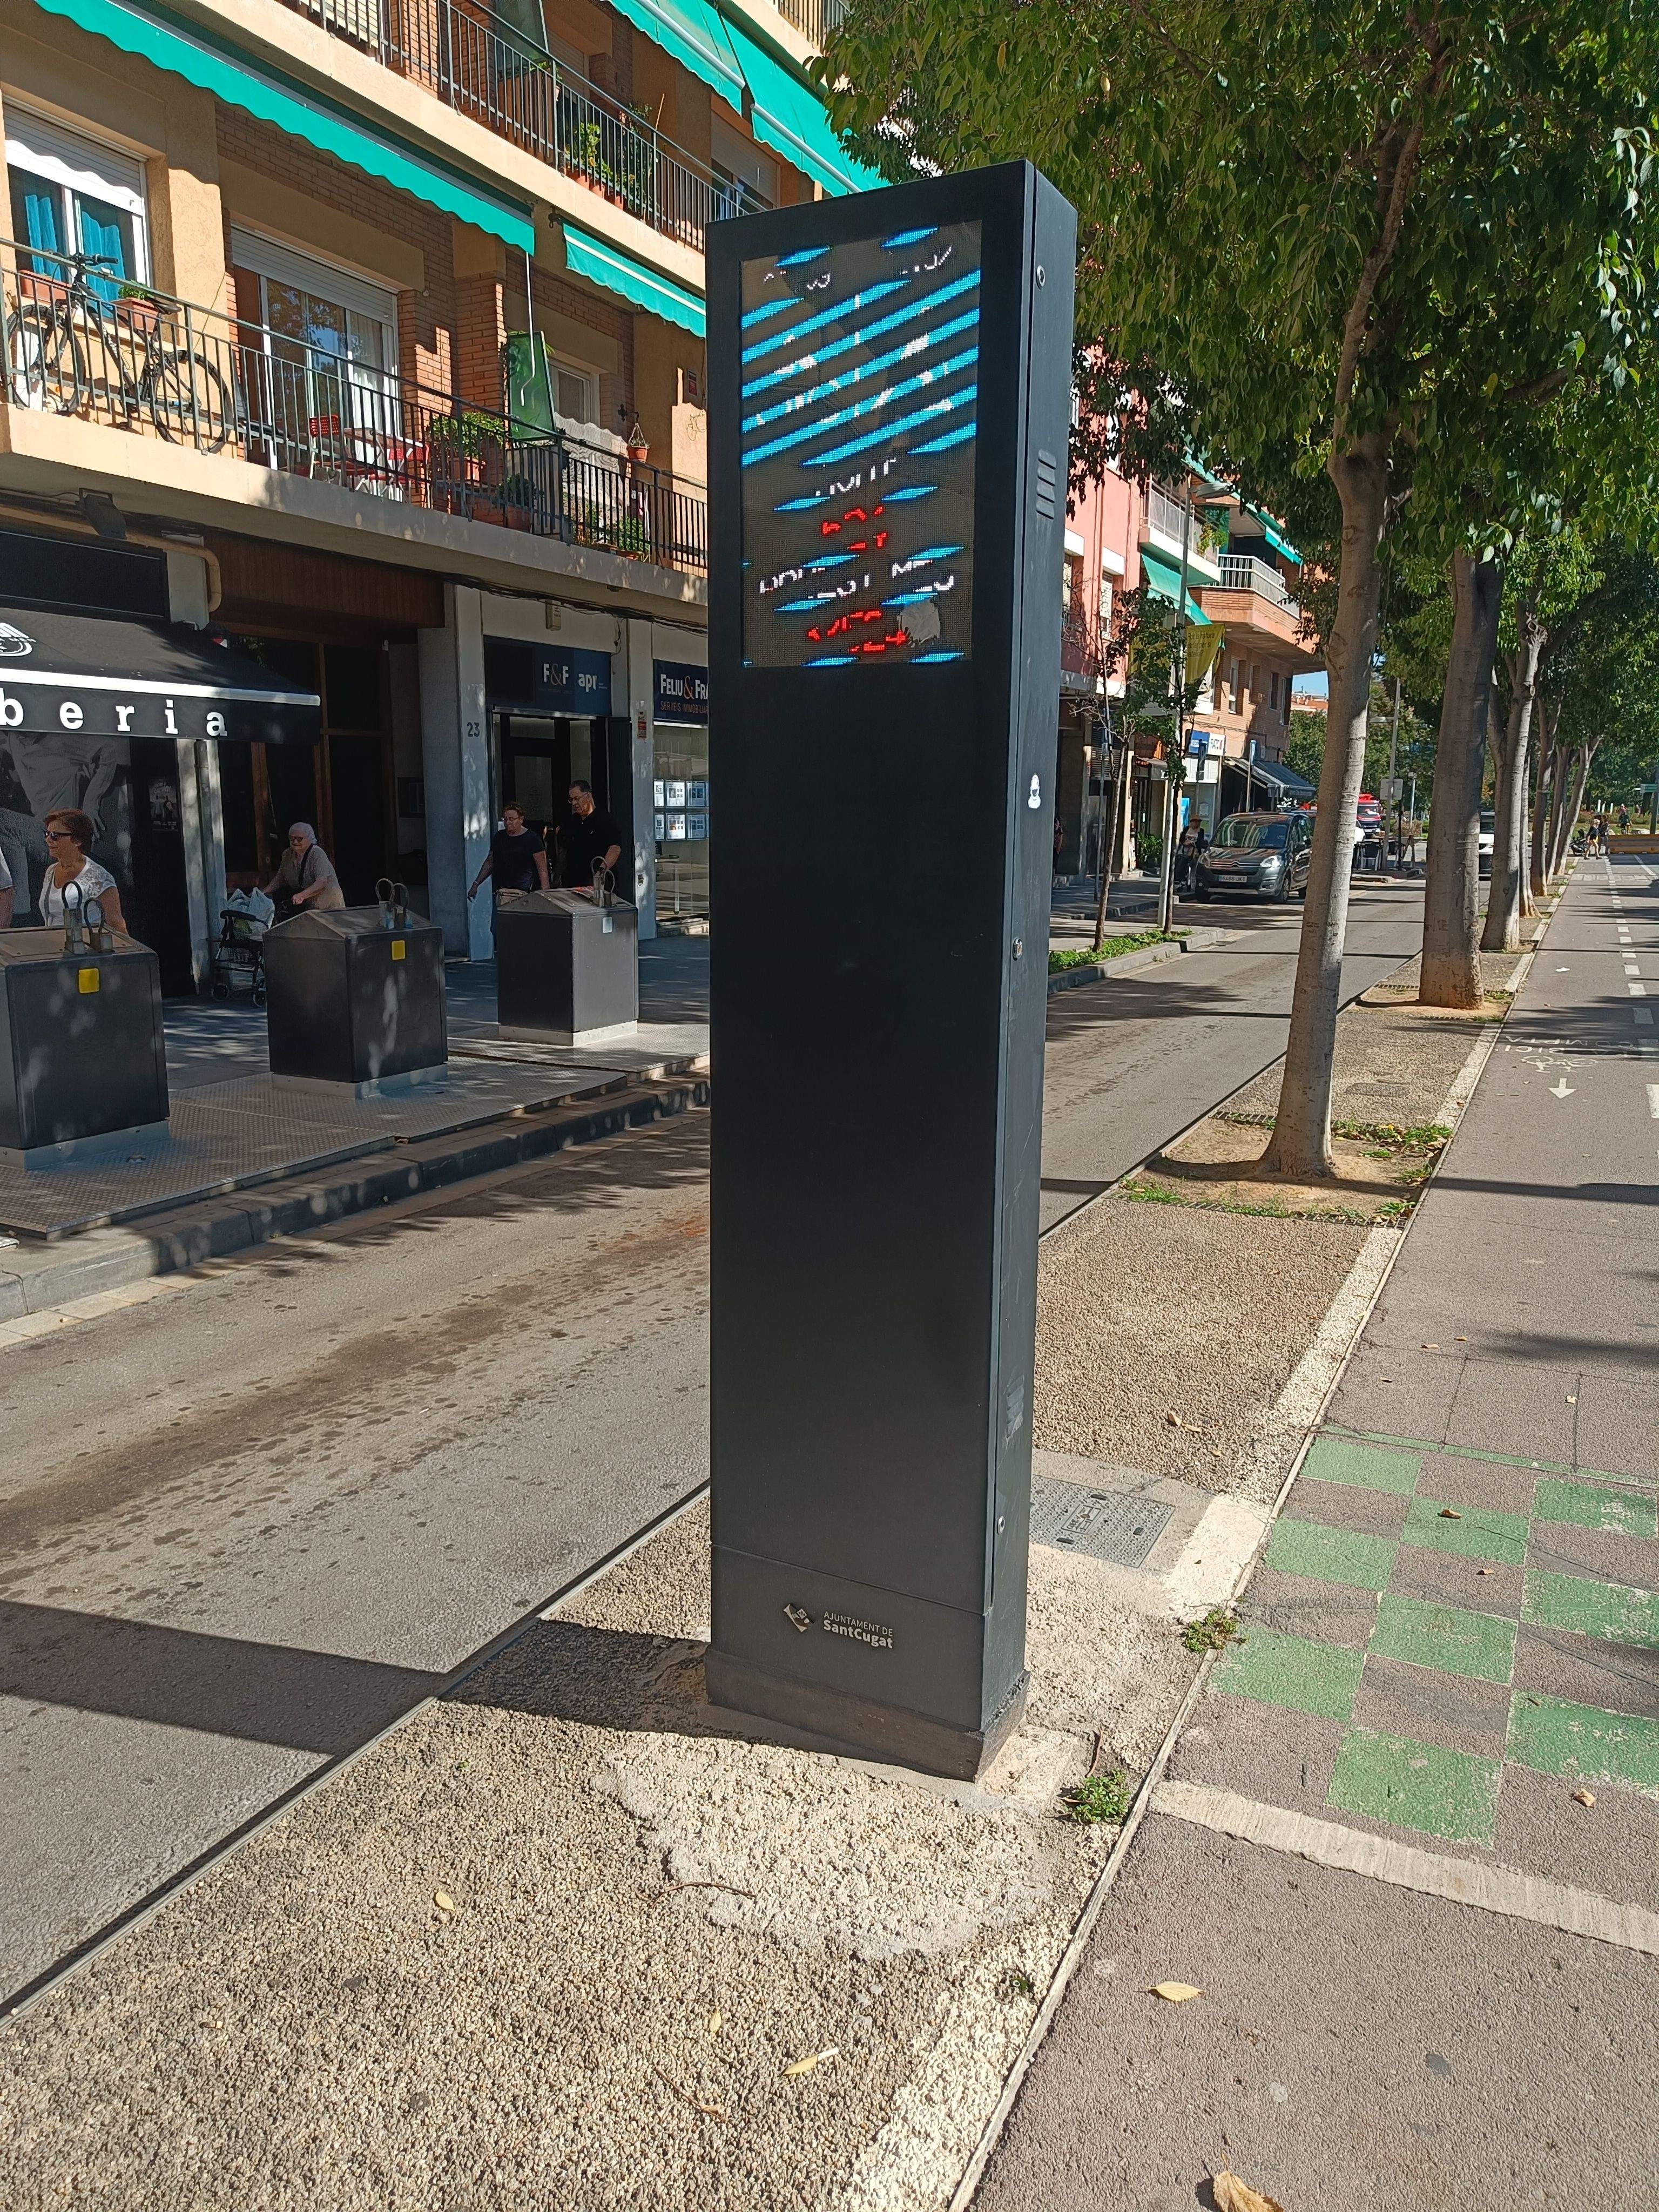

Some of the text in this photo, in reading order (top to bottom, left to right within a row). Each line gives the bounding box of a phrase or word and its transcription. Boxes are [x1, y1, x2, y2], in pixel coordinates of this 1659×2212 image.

[543, 663, 569, 686] F&F
[0, 688, 227, 737] beria
[660, 701, 681, 712] SERVEIS
[467, 722, 480, 737] 23
[823, 1620, 893, 1649] SantCugat
[824, 1611, 893, 1637] AJUNTAMENT DE
